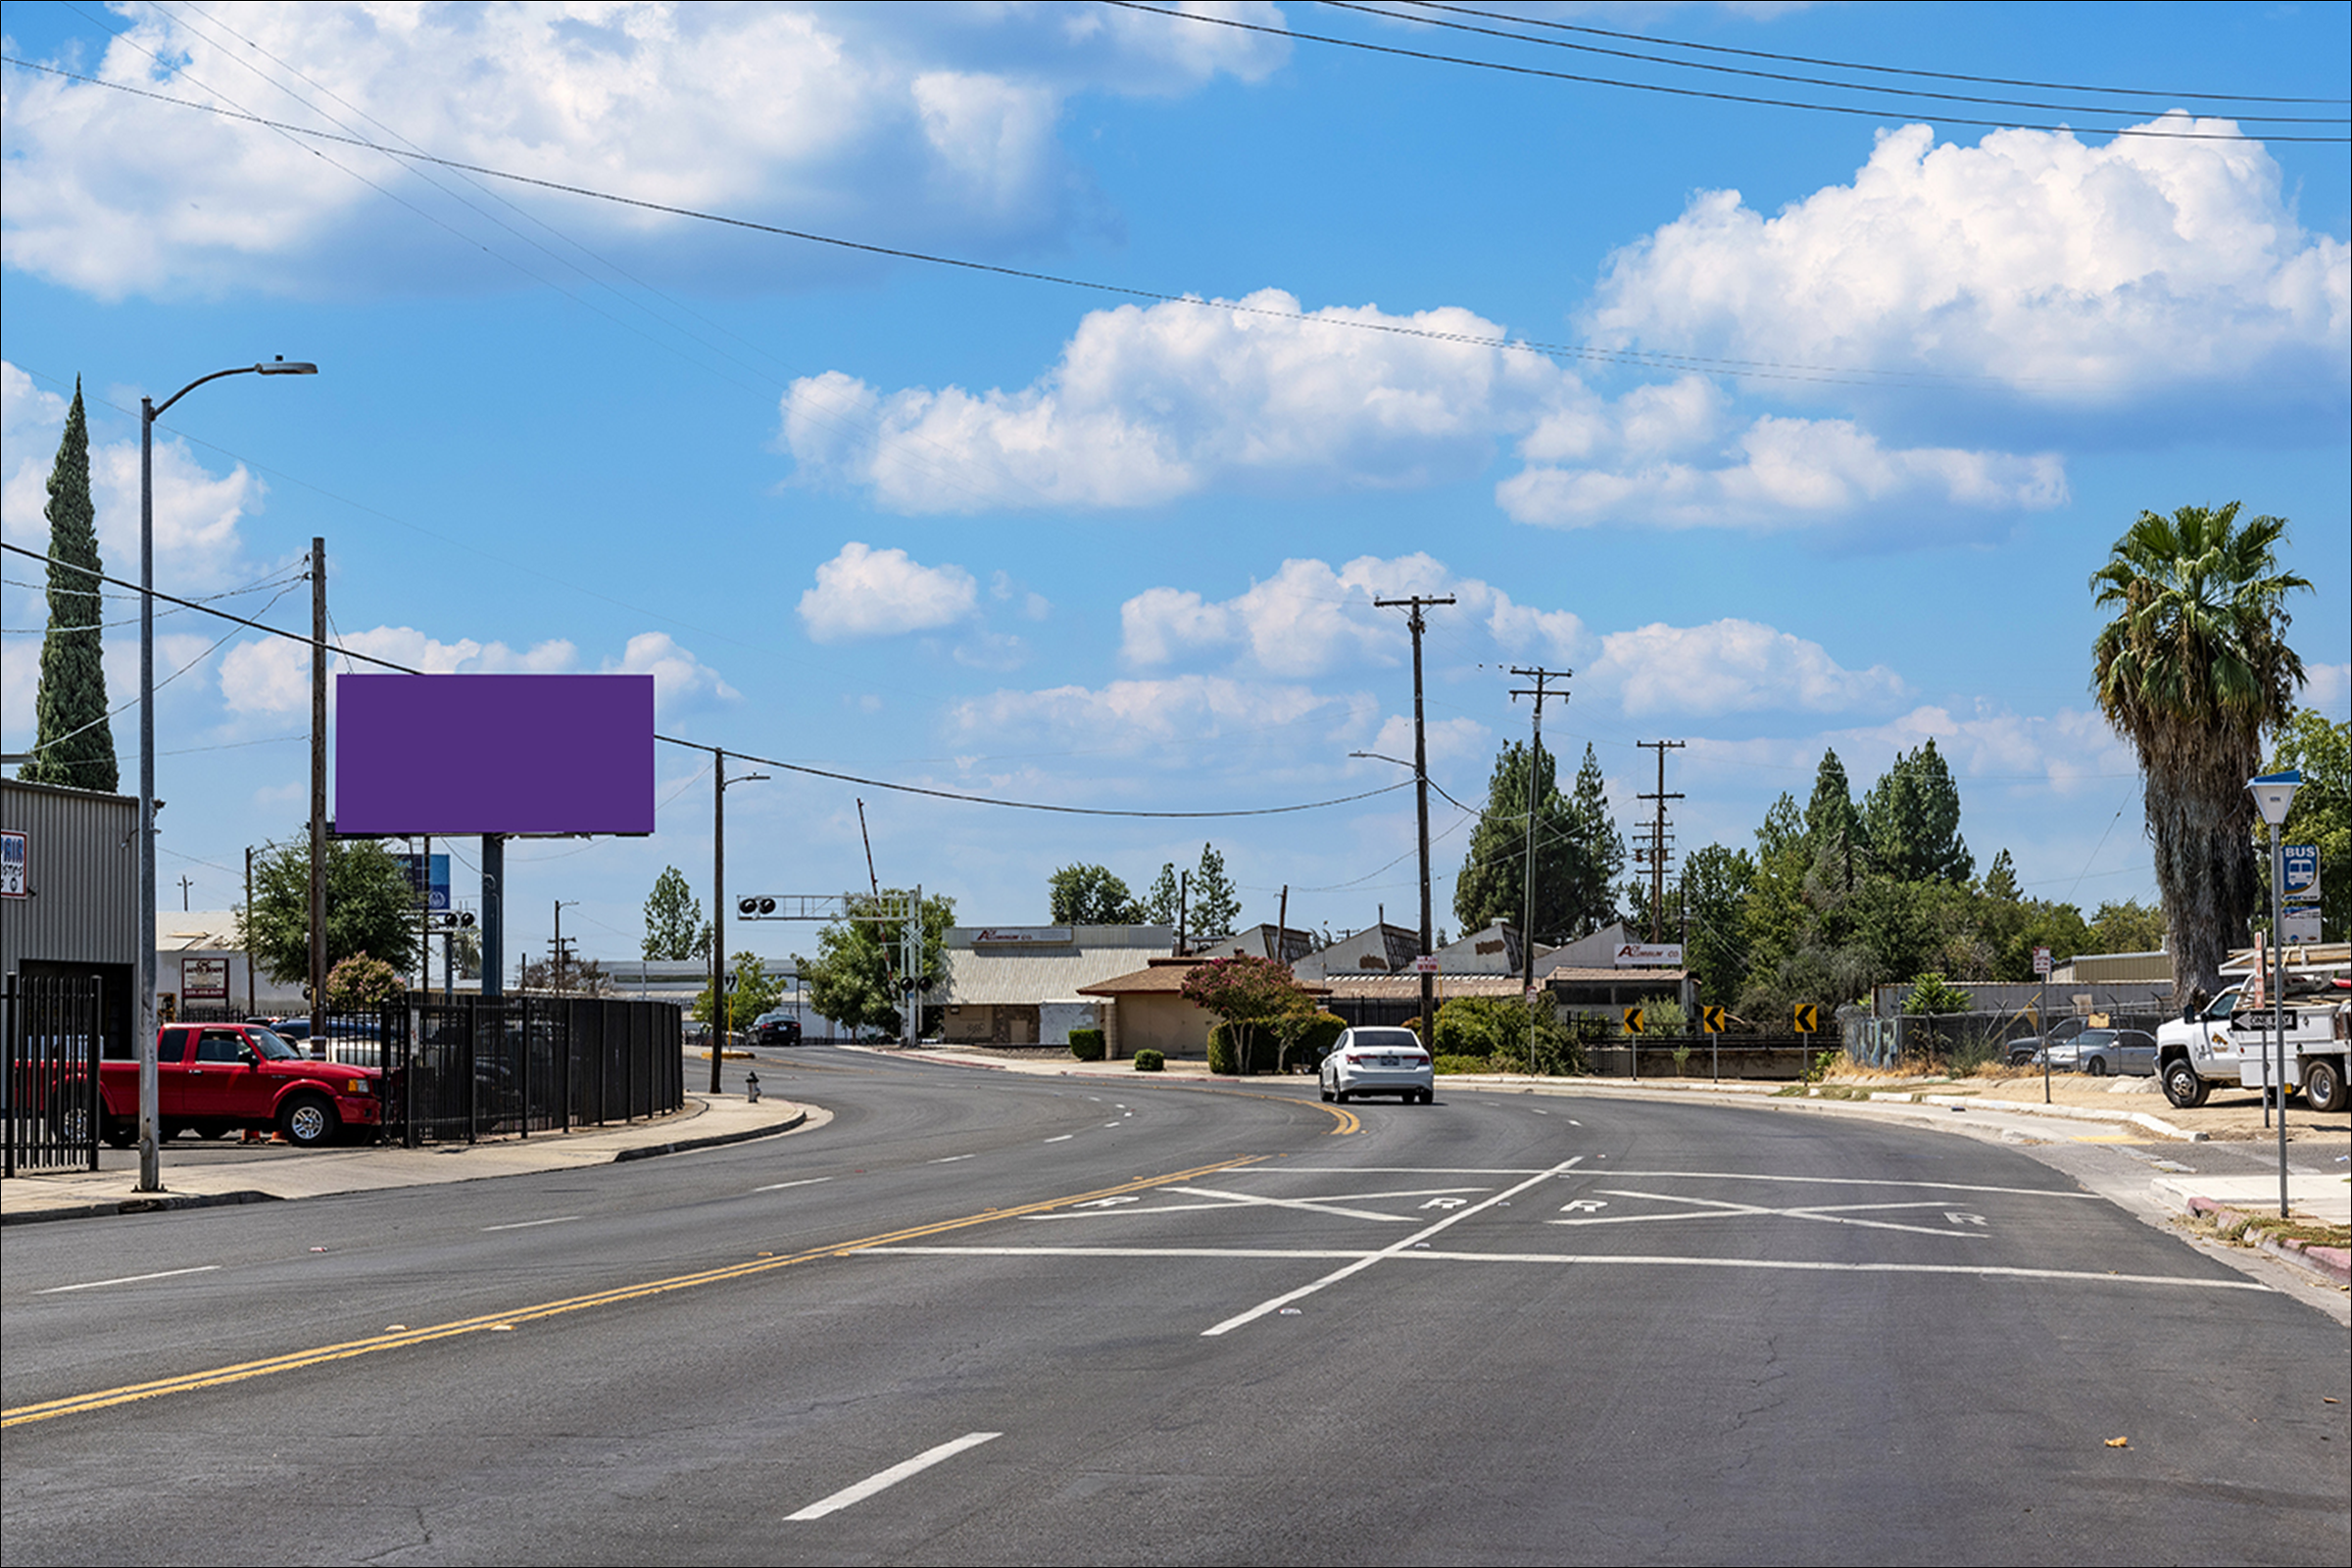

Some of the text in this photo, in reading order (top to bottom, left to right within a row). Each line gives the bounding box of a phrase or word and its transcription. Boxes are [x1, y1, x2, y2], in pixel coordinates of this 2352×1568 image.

[2285, 846, 2316, 858] BUS
[2268, 1015, 2292, 1026] WY
[1418, 1198, 1467, 1209] R
[1559, 1200, 1608, 1212] R
[1943, 1212, 1988, 1226] R
